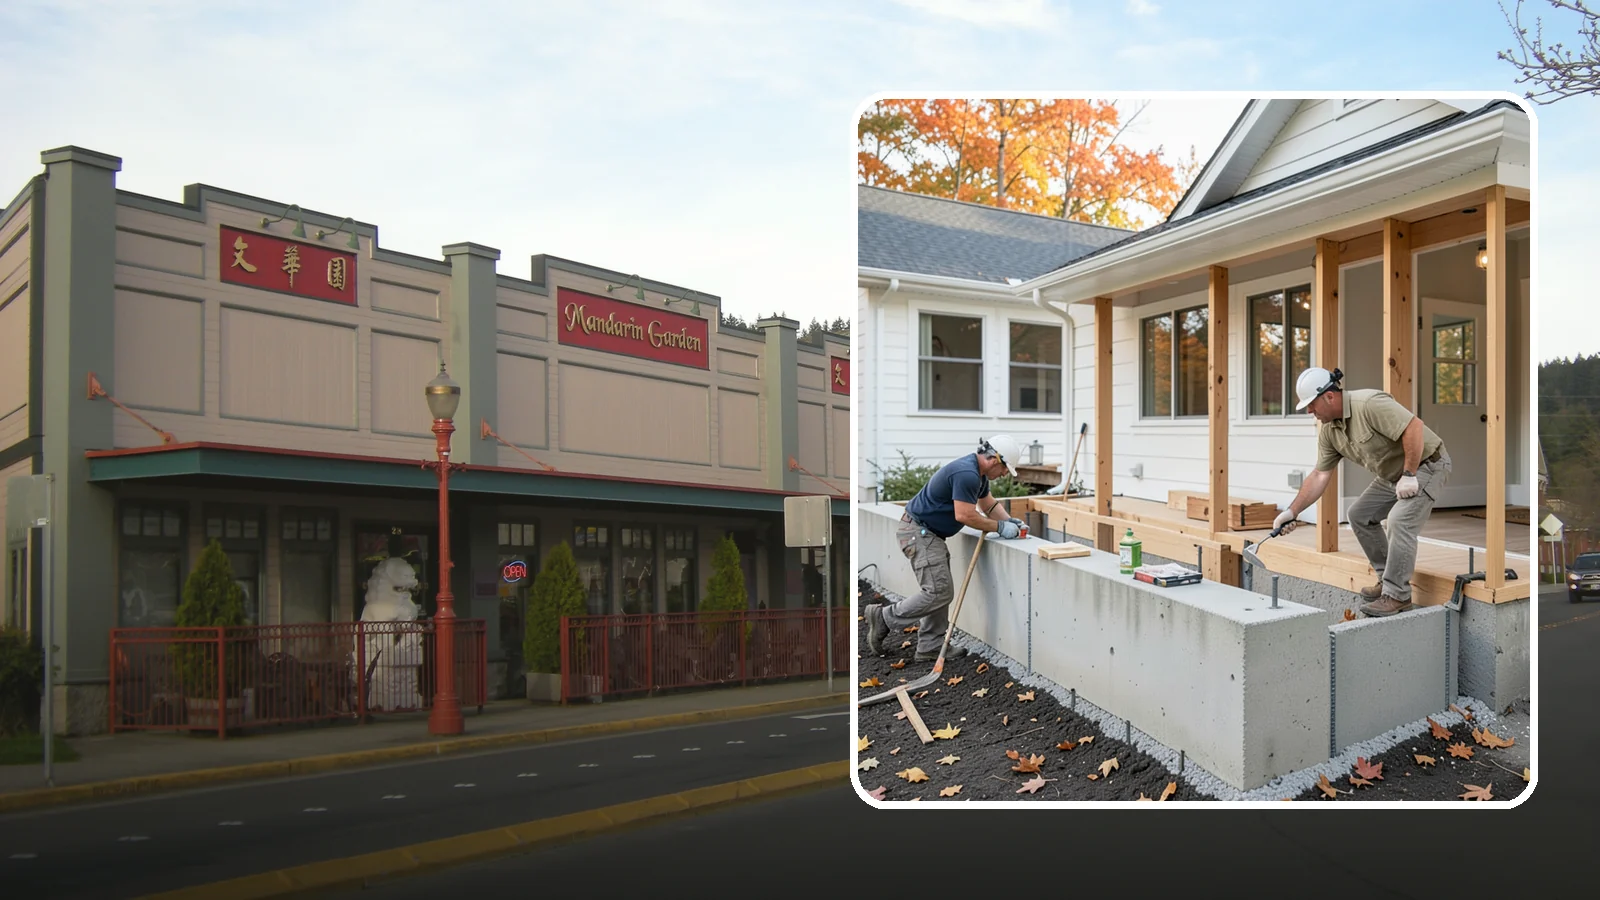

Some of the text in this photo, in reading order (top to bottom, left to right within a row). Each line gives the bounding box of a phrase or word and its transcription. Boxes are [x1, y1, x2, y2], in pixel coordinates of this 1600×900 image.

[230, 235, 346, 291] 文華園
[564, 302, 701, 352] Mandarin Garden
[503, 565, 527, 578] OPEN
